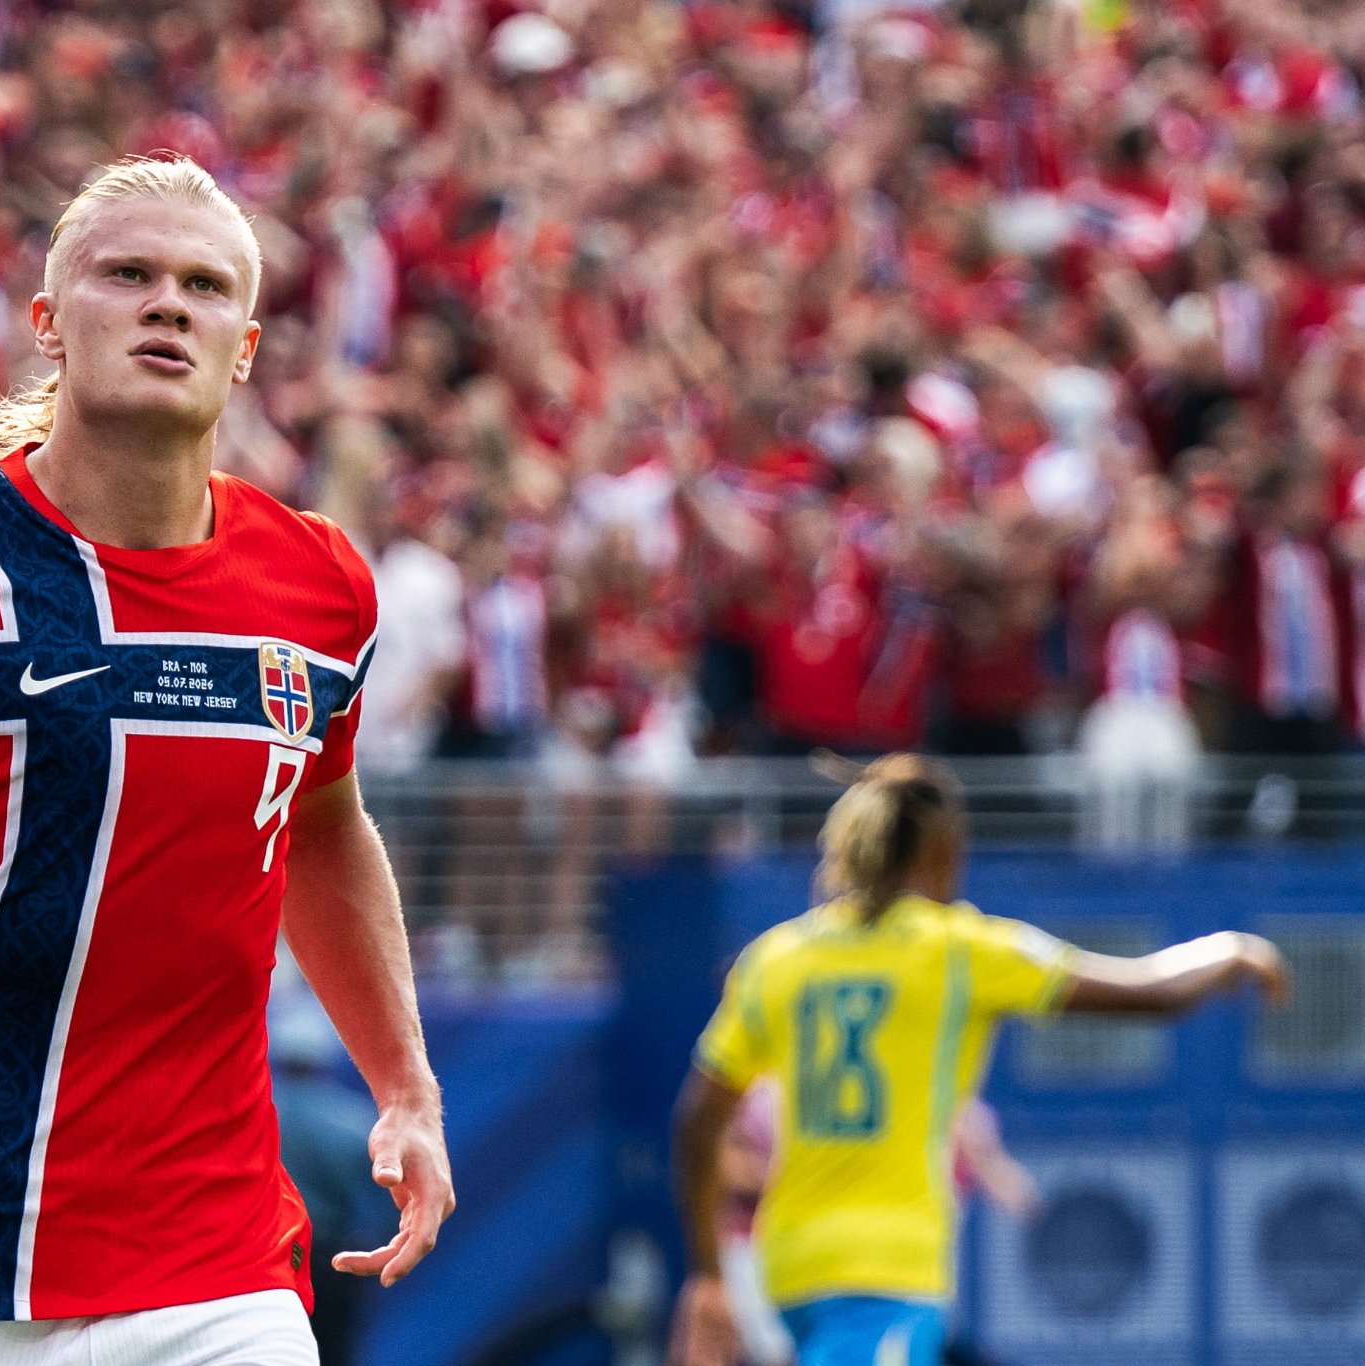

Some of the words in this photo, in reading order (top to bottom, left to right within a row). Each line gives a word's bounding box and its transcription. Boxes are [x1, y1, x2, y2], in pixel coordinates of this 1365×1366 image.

[162, 660, 180, 673] BRA
[190, 662, 208, 674] NOR
[157, 676, 214, 690] 05.07.2026
[133, 691, 152, 703] NEW
[155, 693, 180, 706] YORK
[182, 696, 201, 707] NEW
[204, 697, 237, 709] JERSEY
[253, 743, 307, 873] 9
